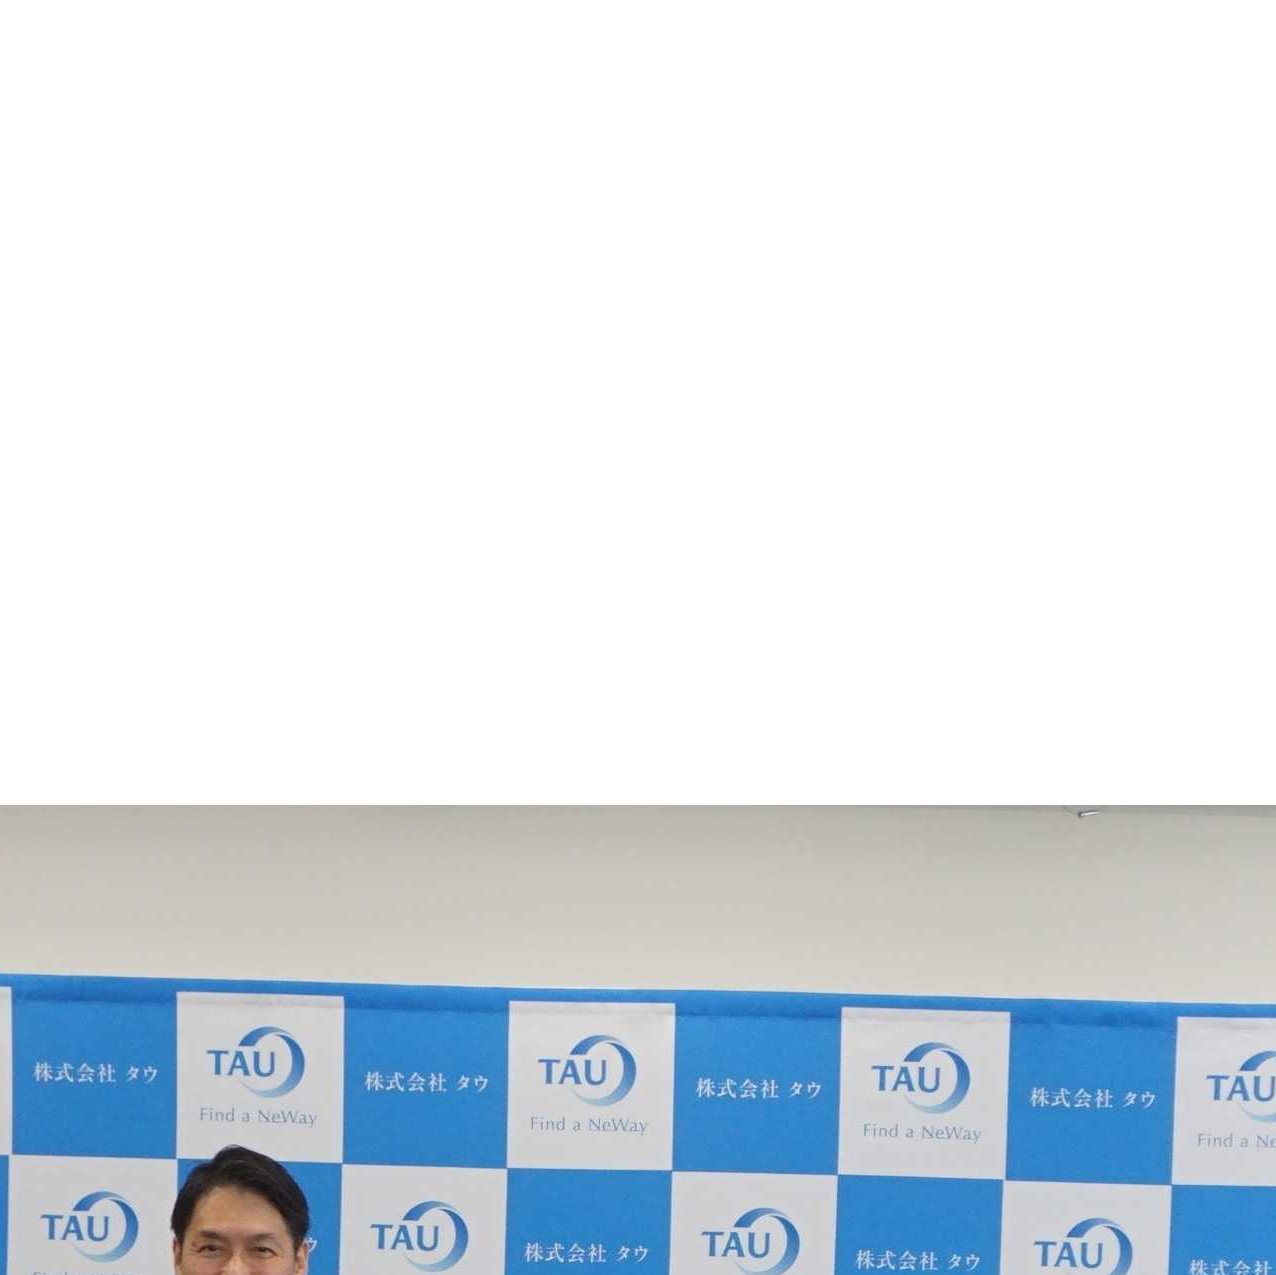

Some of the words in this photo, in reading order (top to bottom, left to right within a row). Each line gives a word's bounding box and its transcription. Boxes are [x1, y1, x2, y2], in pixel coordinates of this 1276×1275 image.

[33, 1061, 117, 1083] 株式会社
[127, 1065, 158, 1082] タウ
[206, 1049, 276, 1078] TAU
[537, 1058, 607, 1086] TAU
[364, 1071, 447, 1093] 株式会社
[457, 1074, 489, 1092] タウ
[695, 1077, 780, 1099] 株式会社
[790, 1081, 822, 1098] タウ
[871, 1065, 941, 1094] TAU
[1205, 1074, 1276, 1103] TAU
[1029, 1087, 1114, 1109] 株式会社
[1124, 1091, 1156, 1108] タウ
[199, 1107, 236, 1123] Find
[241, 1111, 251, 1123] a
[257, 1109, 318, 1129] NeWay
[530, 1116, 566, 1131] Find
[572, 1121, 581, 1132] a
[588, 1117, 648, 1136] NeWay
[863, 1123, 899, 1138] Find
[905, 1127, 914, 1139] a
[921, 1125, 982, 1145] NeWay
[1197, 1131, 1234, 1148] Find
[1239, 1137, 1249, 1148] a
[40, 1213, 110, 1242] TAU
[370, 1223, 440, 1252] TAU
[524, 1242, 607, 1264] 株式会社
[617, 1245, 649, 1262] タウ
[700, 1231, 771, 1259] TAU
[1033, 1240, 1103, 1269] TAU
[855, 1249, 938, 1271] 株式会社
[948, 1253, 981, 1271] タウ
